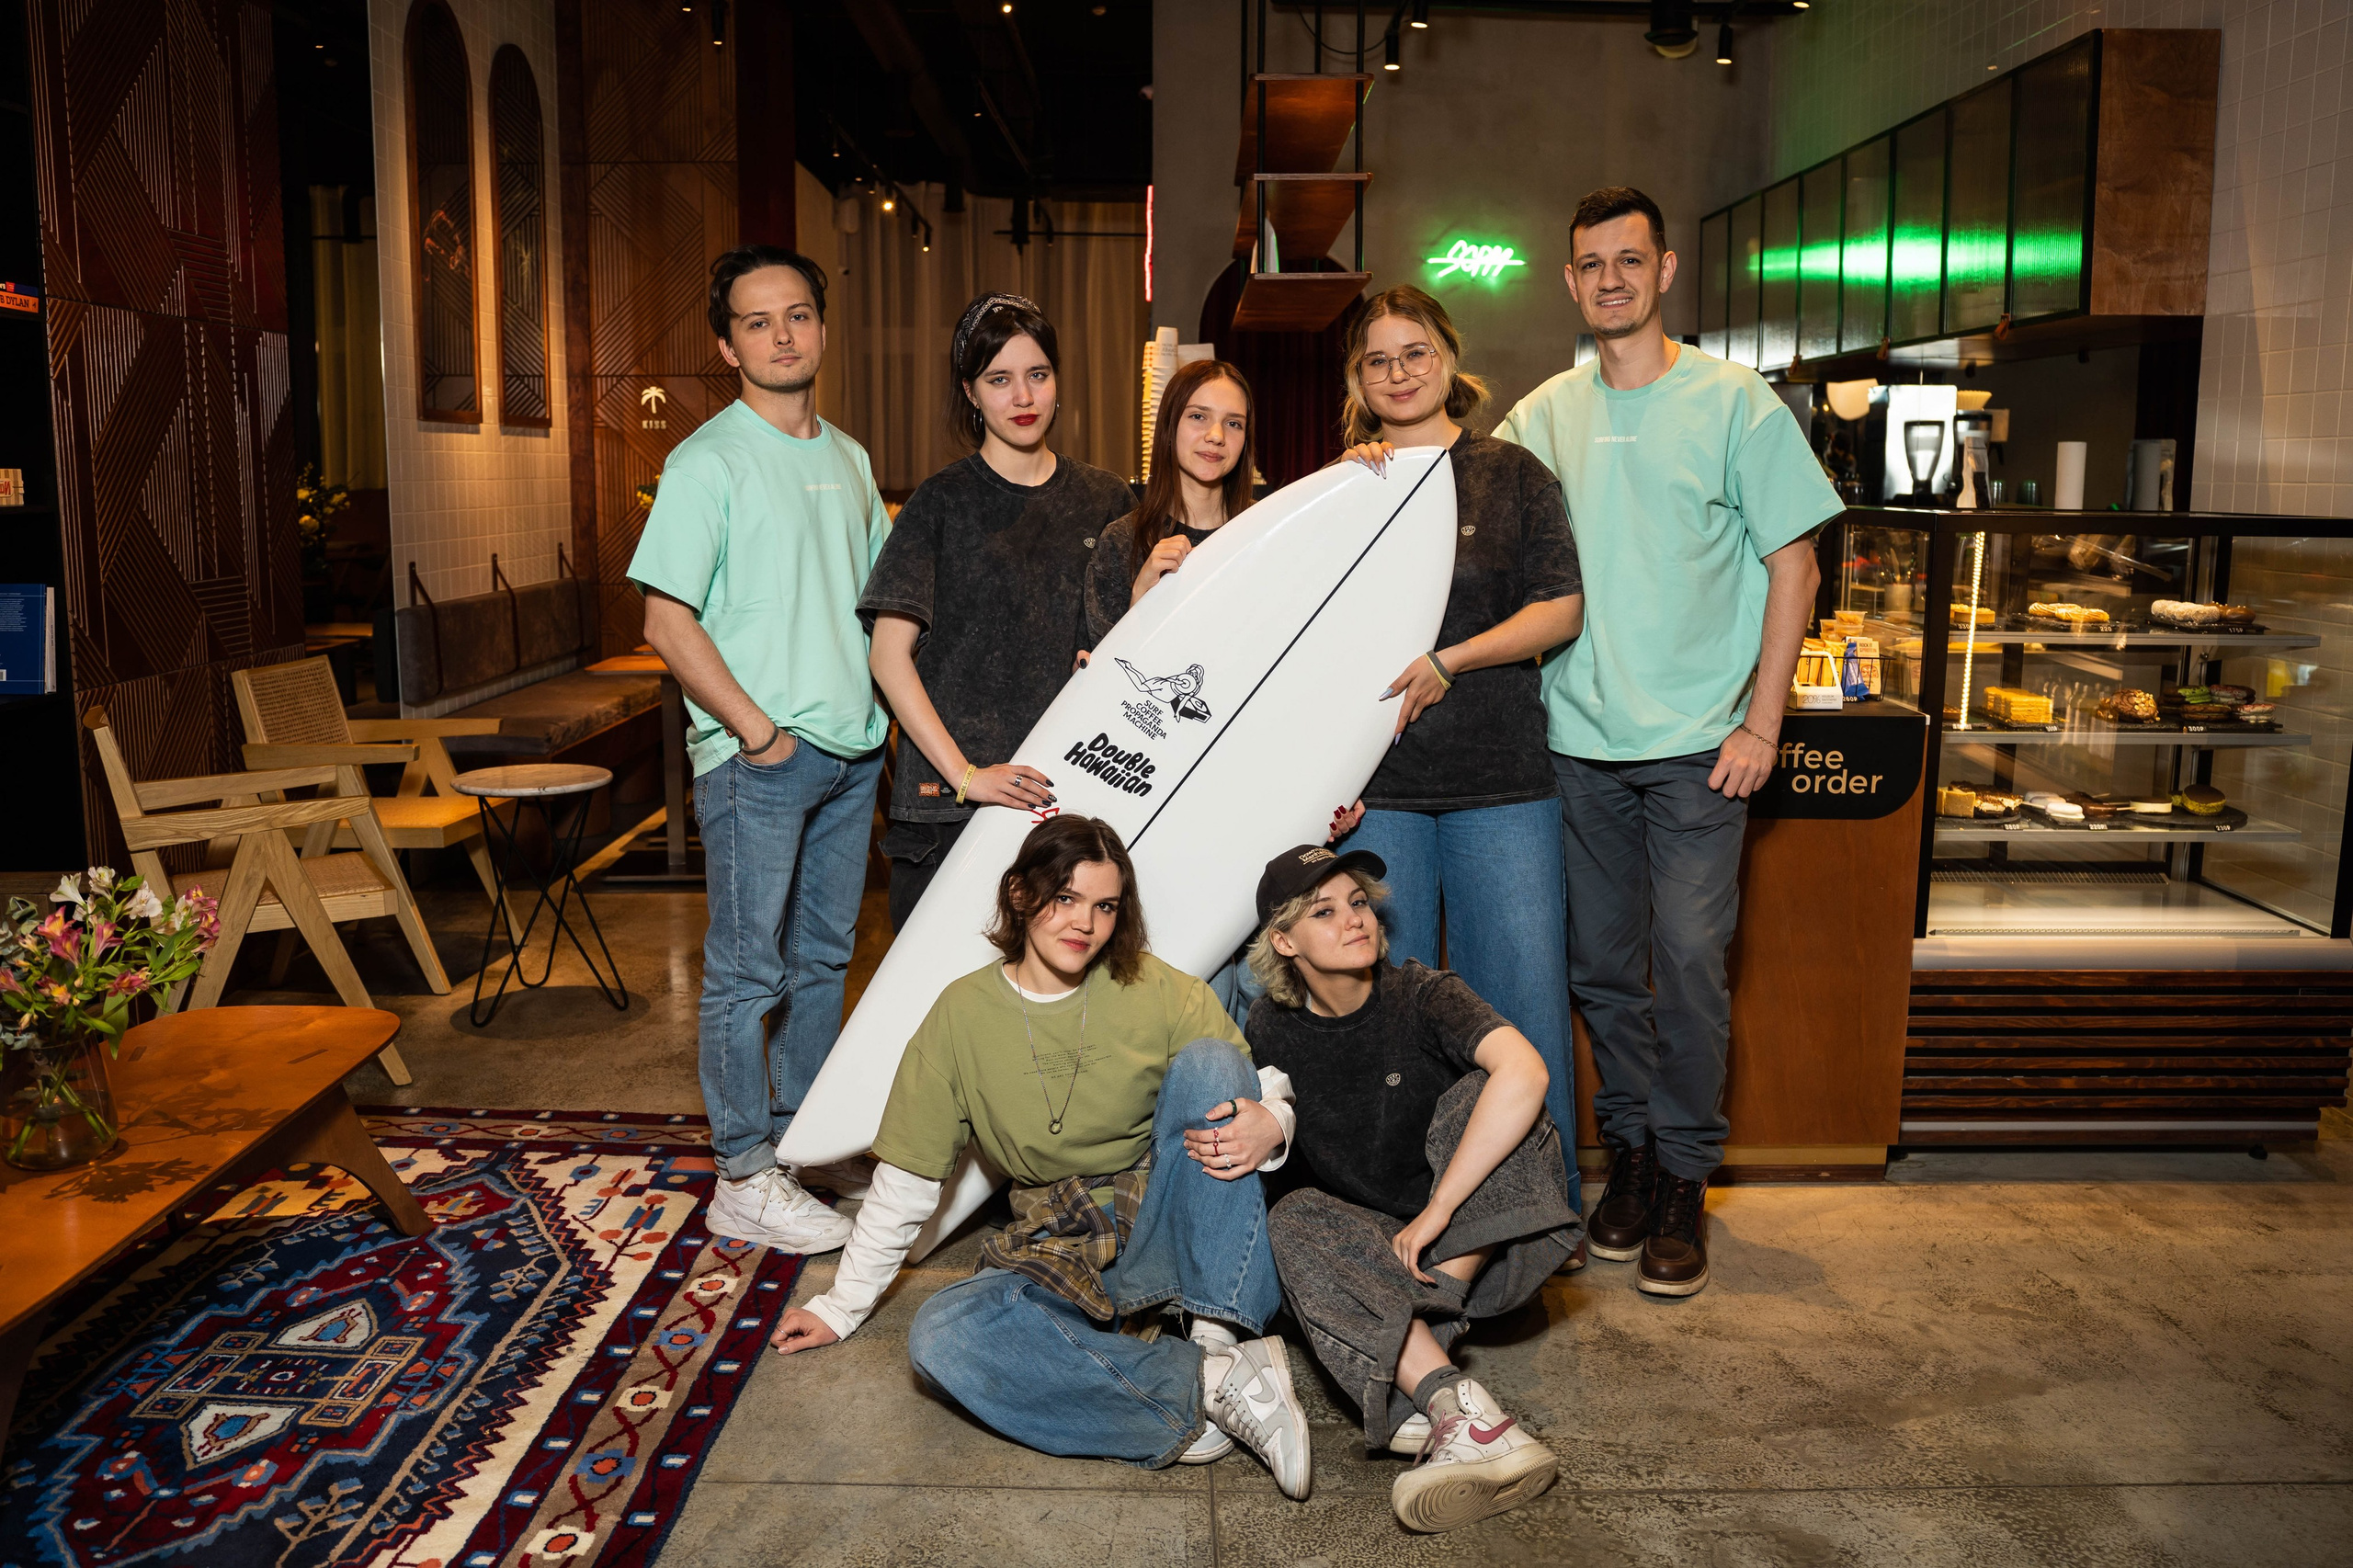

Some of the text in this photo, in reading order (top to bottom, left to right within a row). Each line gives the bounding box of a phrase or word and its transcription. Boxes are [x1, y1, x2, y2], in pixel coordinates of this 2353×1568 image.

[6, 296, 29, 308] DYLAN
[642, 419, 667, 430] KISS
[1143, 699, 1165, 716] SURF
[1802, 694, 1821, 704] 20%
[1120, 699, 1167, 740] PROPAGANDA
[1122, 710, 1158, 741] MACHINE
[1135, 702, 1164, 726] COFFEE
[1772, 742, 1844, 770] ffee
[1063, 741, 1153, 797] Hawaiian
[1791, 768, 1883, 795] order
